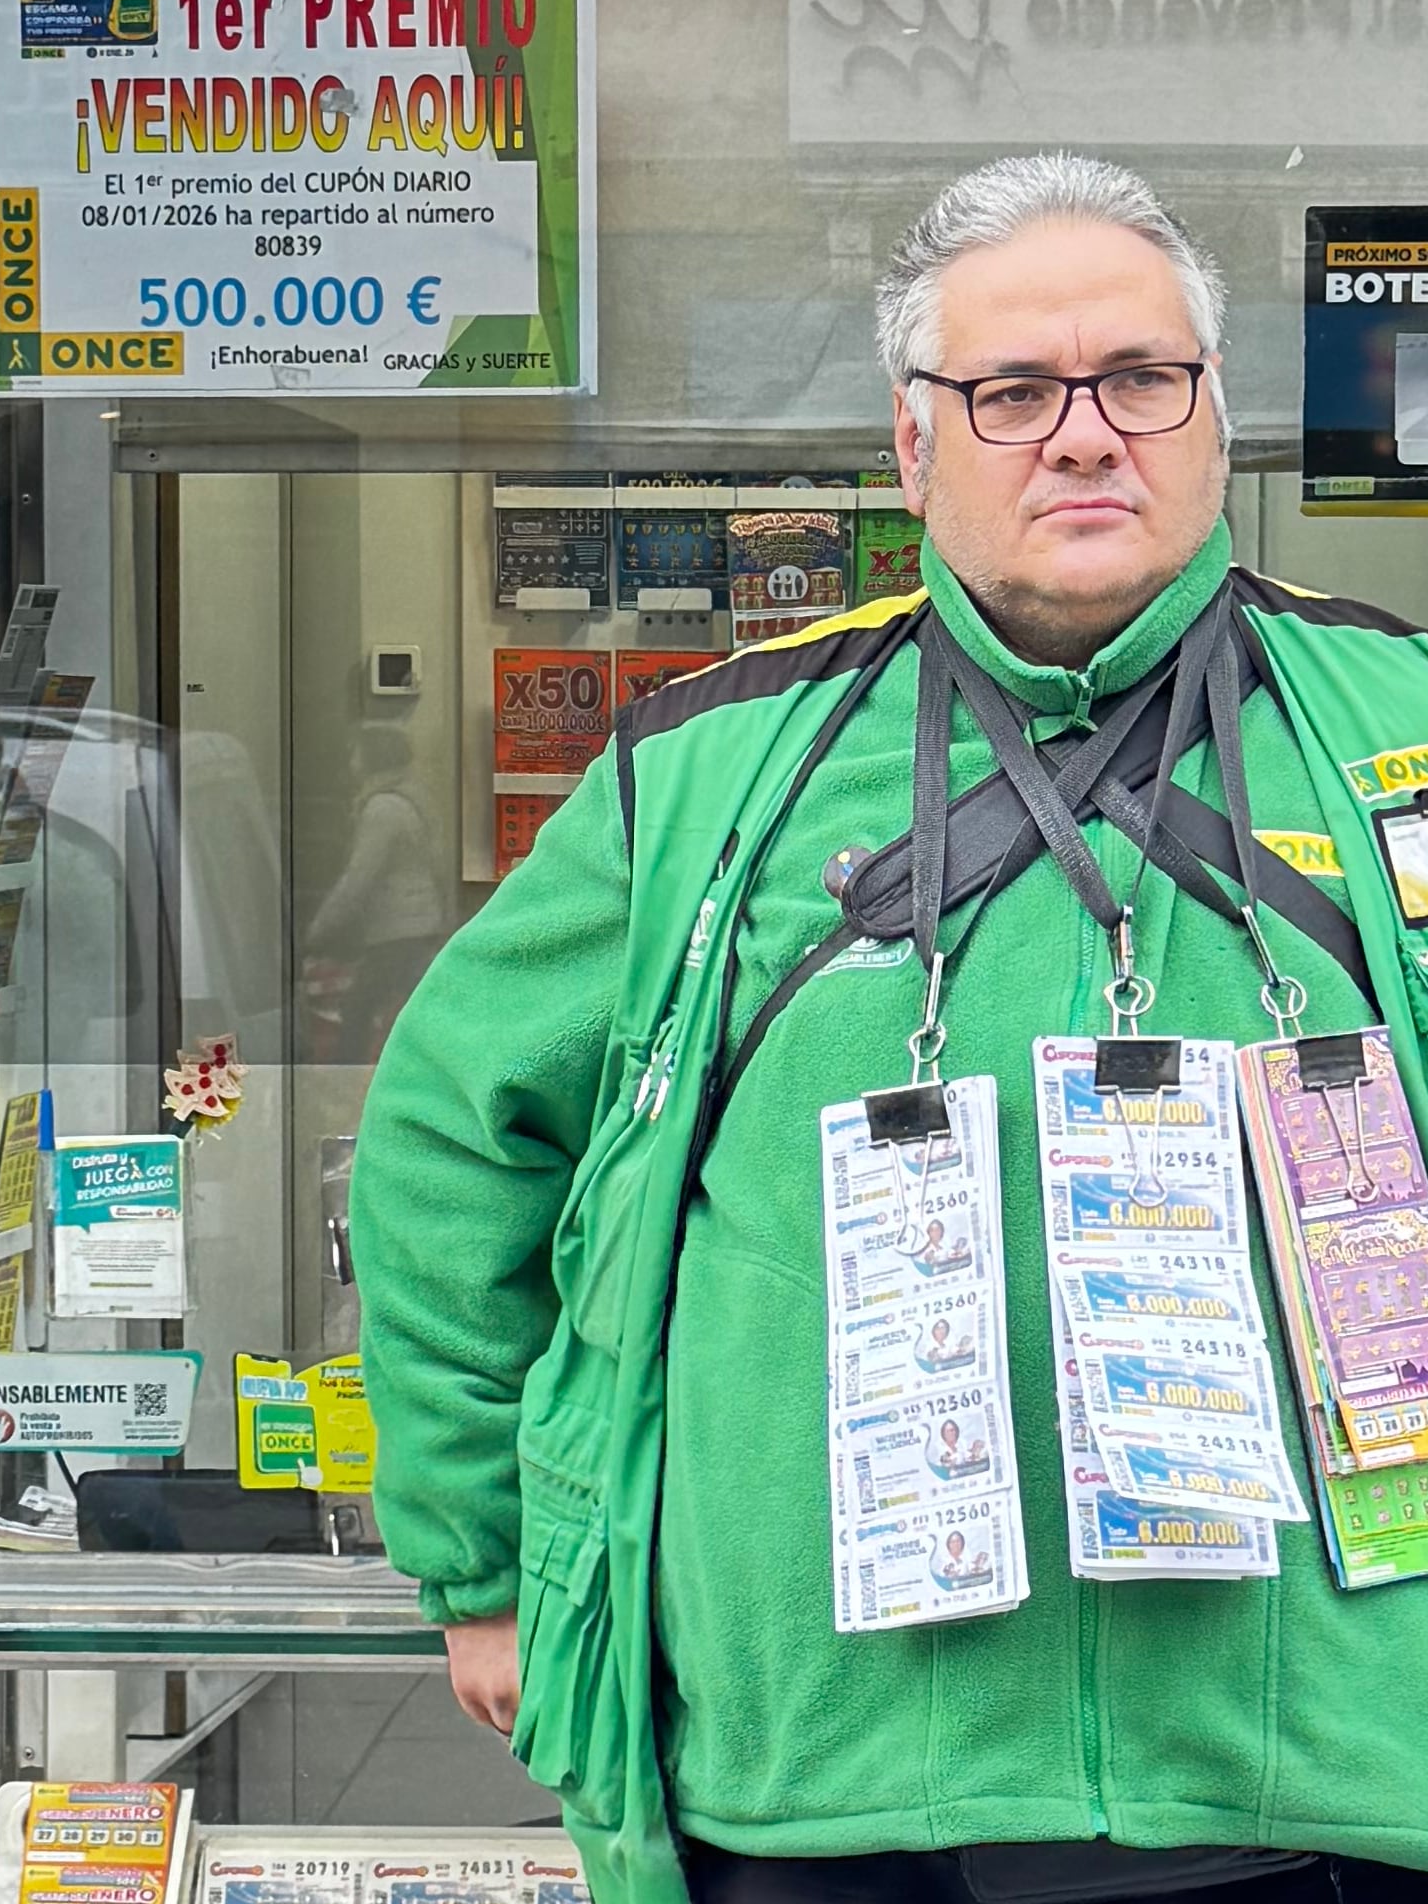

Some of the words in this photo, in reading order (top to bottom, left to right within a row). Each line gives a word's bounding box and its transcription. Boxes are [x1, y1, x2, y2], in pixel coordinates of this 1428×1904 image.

[76, 75, 351, 174] ¡VENDIDO
[367, 55, 526, 158] AQUÍ!
[104, 173, 126, 195] El
[171, 175, 253, 199] premio
[260, 171, 298, 194] del
[304, 165, 386, 194] CUPÓN
[393, 170, 472, 193] DIARIO
[80, 203, 219, 229] 08/01/2026
[225, 204, 253, 226] ha
[261, 201, 370, 229] repartido
[376, 202, 400, 225] al
[406, 200, 495, 224] número
[2, 196, 34, 323] ONCE
[254, 235, 323, 258] 80839
[1333, 243, 1412, 264] PRÓXIMO
[138, 277, 384, 328] 500.000
[407, 275, 442, 326] €
[50, 336, 175, 370] ONCE
[210, 343, 369, 369] ¡Enhorabuena!
[383, 350, 461, 372] GRACIAS
[465, 356, 478, 375] y
[481, 349, 551, 371] SUERTE
[503, 664, 602, 711] x50
[916, 1190, 969, 1215] 2560
[264, 1435, 311, 1450] ONCE
[37, 1829, 54, 1841] 27
[294, 1861, 351, 1876] 20719
